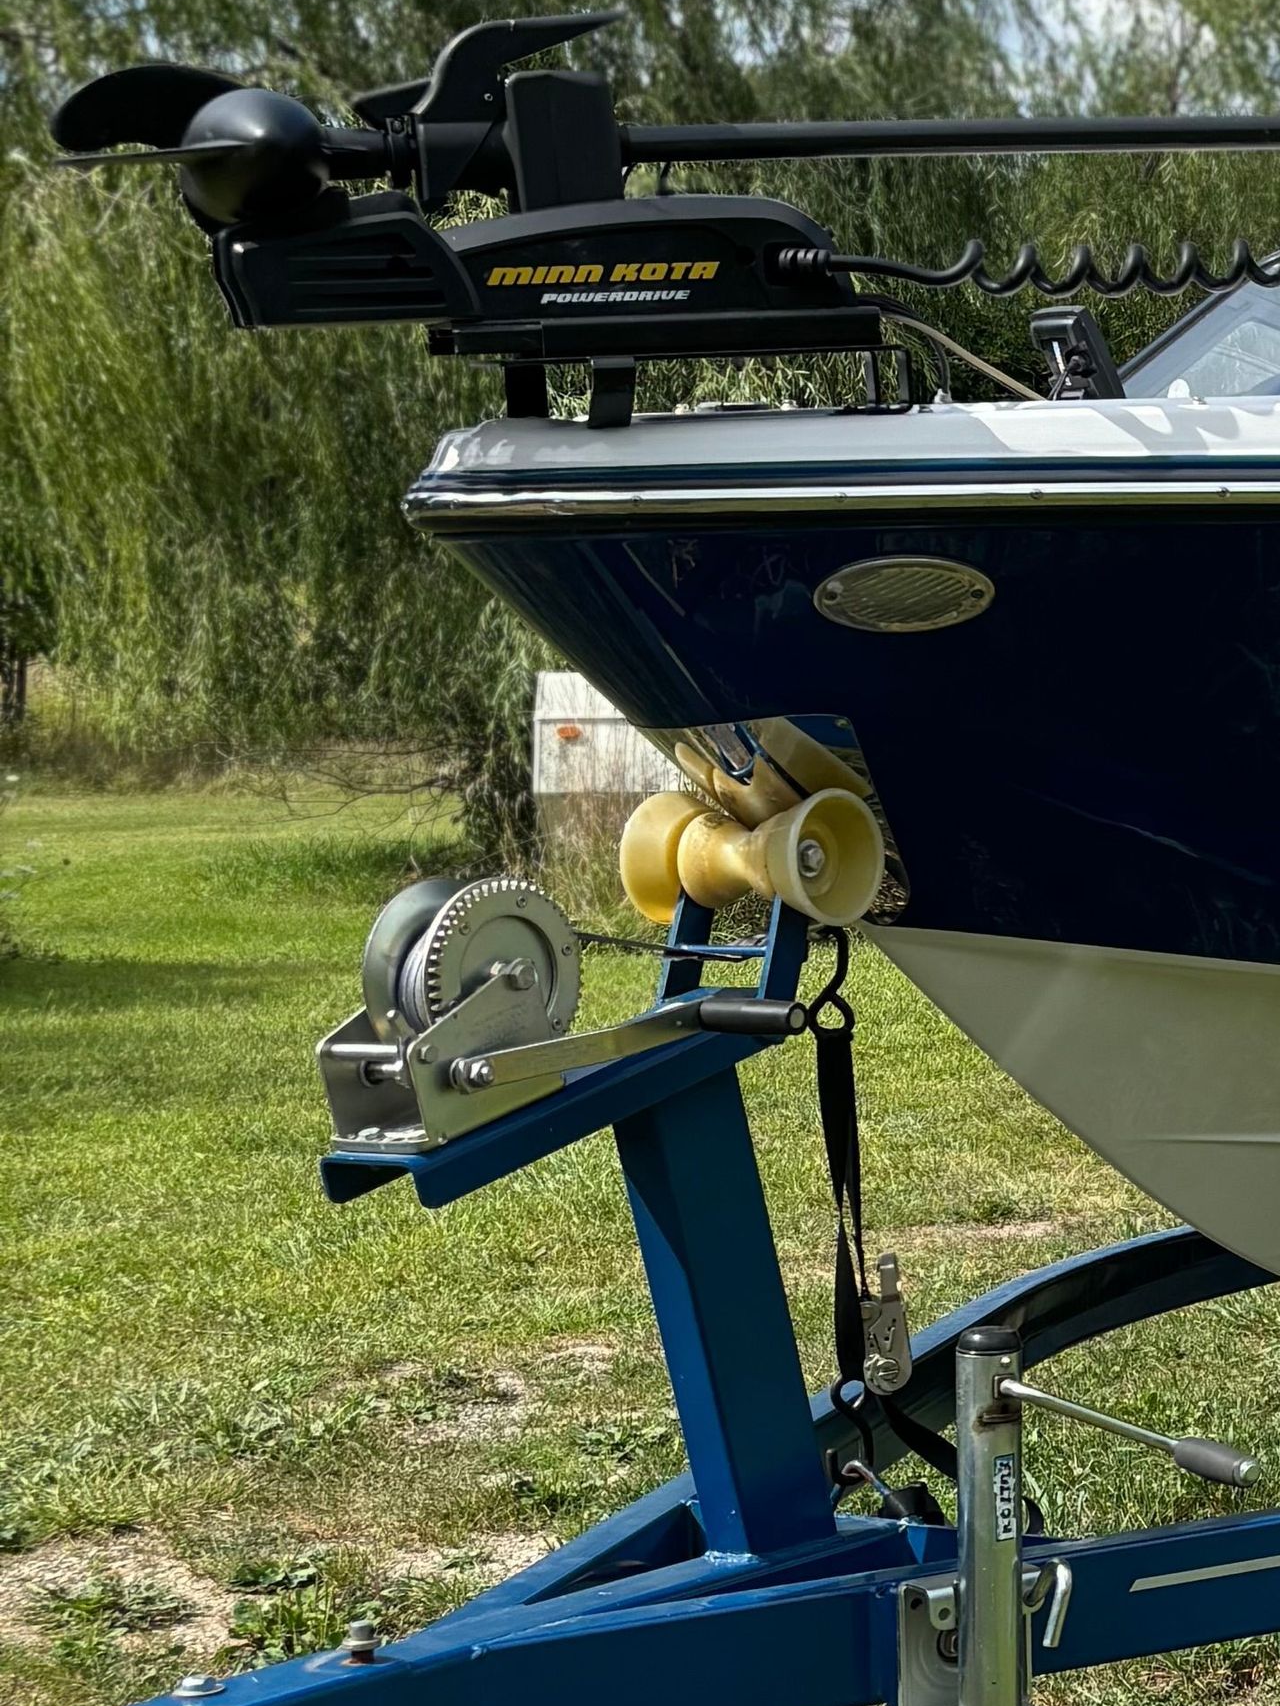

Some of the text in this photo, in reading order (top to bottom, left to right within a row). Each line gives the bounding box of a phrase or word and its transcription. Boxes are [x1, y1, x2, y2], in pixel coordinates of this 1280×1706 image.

[486, 261, 720, 286] MINN KOTA
[540, 289, 691, 305] POWERDRIVE
